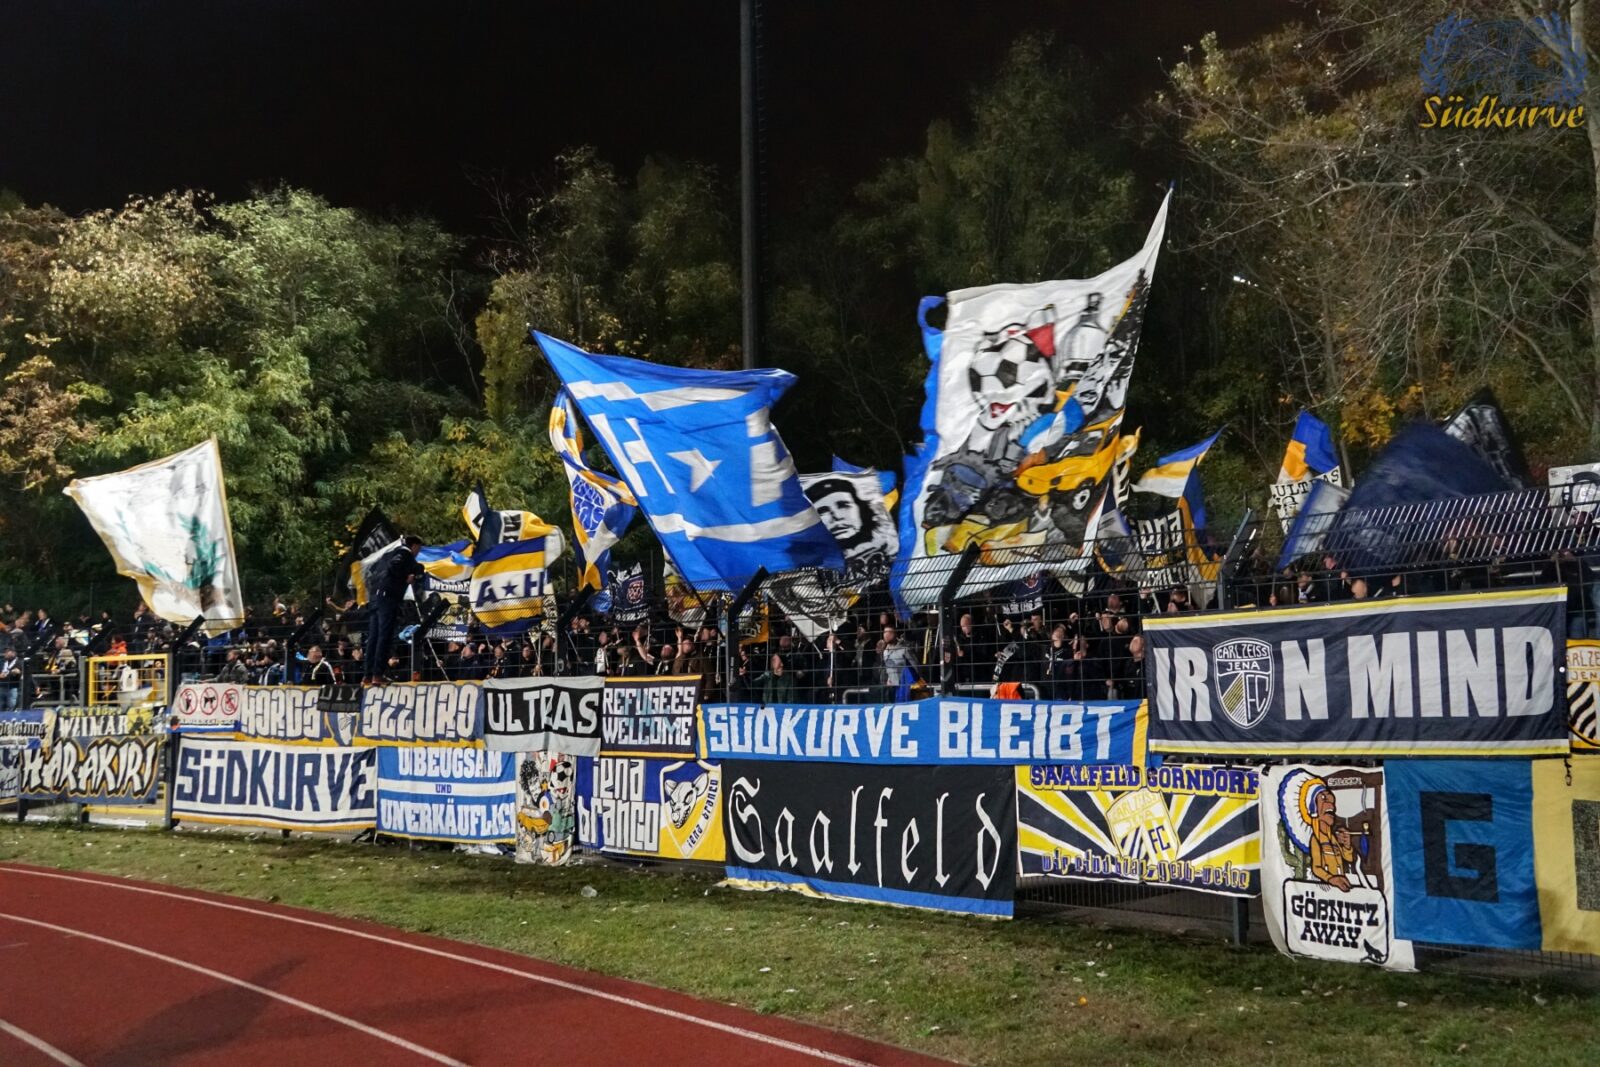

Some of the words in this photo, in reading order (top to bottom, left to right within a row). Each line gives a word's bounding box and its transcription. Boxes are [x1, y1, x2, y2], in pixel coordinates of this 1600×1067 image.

[1275, 469, 1339, 497] ULTAS
[1217, 645, 1242, 659] CARL
[1242, 643, 1268, 659] ZEISS
[1226, 660, 1260, 671] JENA
[1348, 626, 1555, 720] MIND
[487, 688, 600, 735] ULTRAS
[602, 686, 696, 715] REFUGEES
[602, 716, 693, 746] WELCOME
[708, 703, 919, 758] SÜDKURVE
[939, 701, 1126, 760] BLEIBT
[22, 739, 158, 794] HARAKIRI
[173, 748, 377, 812] SÜDKURVE
[1030, 764, 1141, 789] SAALFELD
[1148, 766, 1259, 797] GORNDORF
[435, 784, 452, 794] UND
[702, 779, 719, 820] branco
[728, 776, 1001, 892] Saalfeld
[1148, 825, 1171, 854] FC
[1420, 791, 1499, 903] G
[1300, 920, 1362, 949] AWAY
